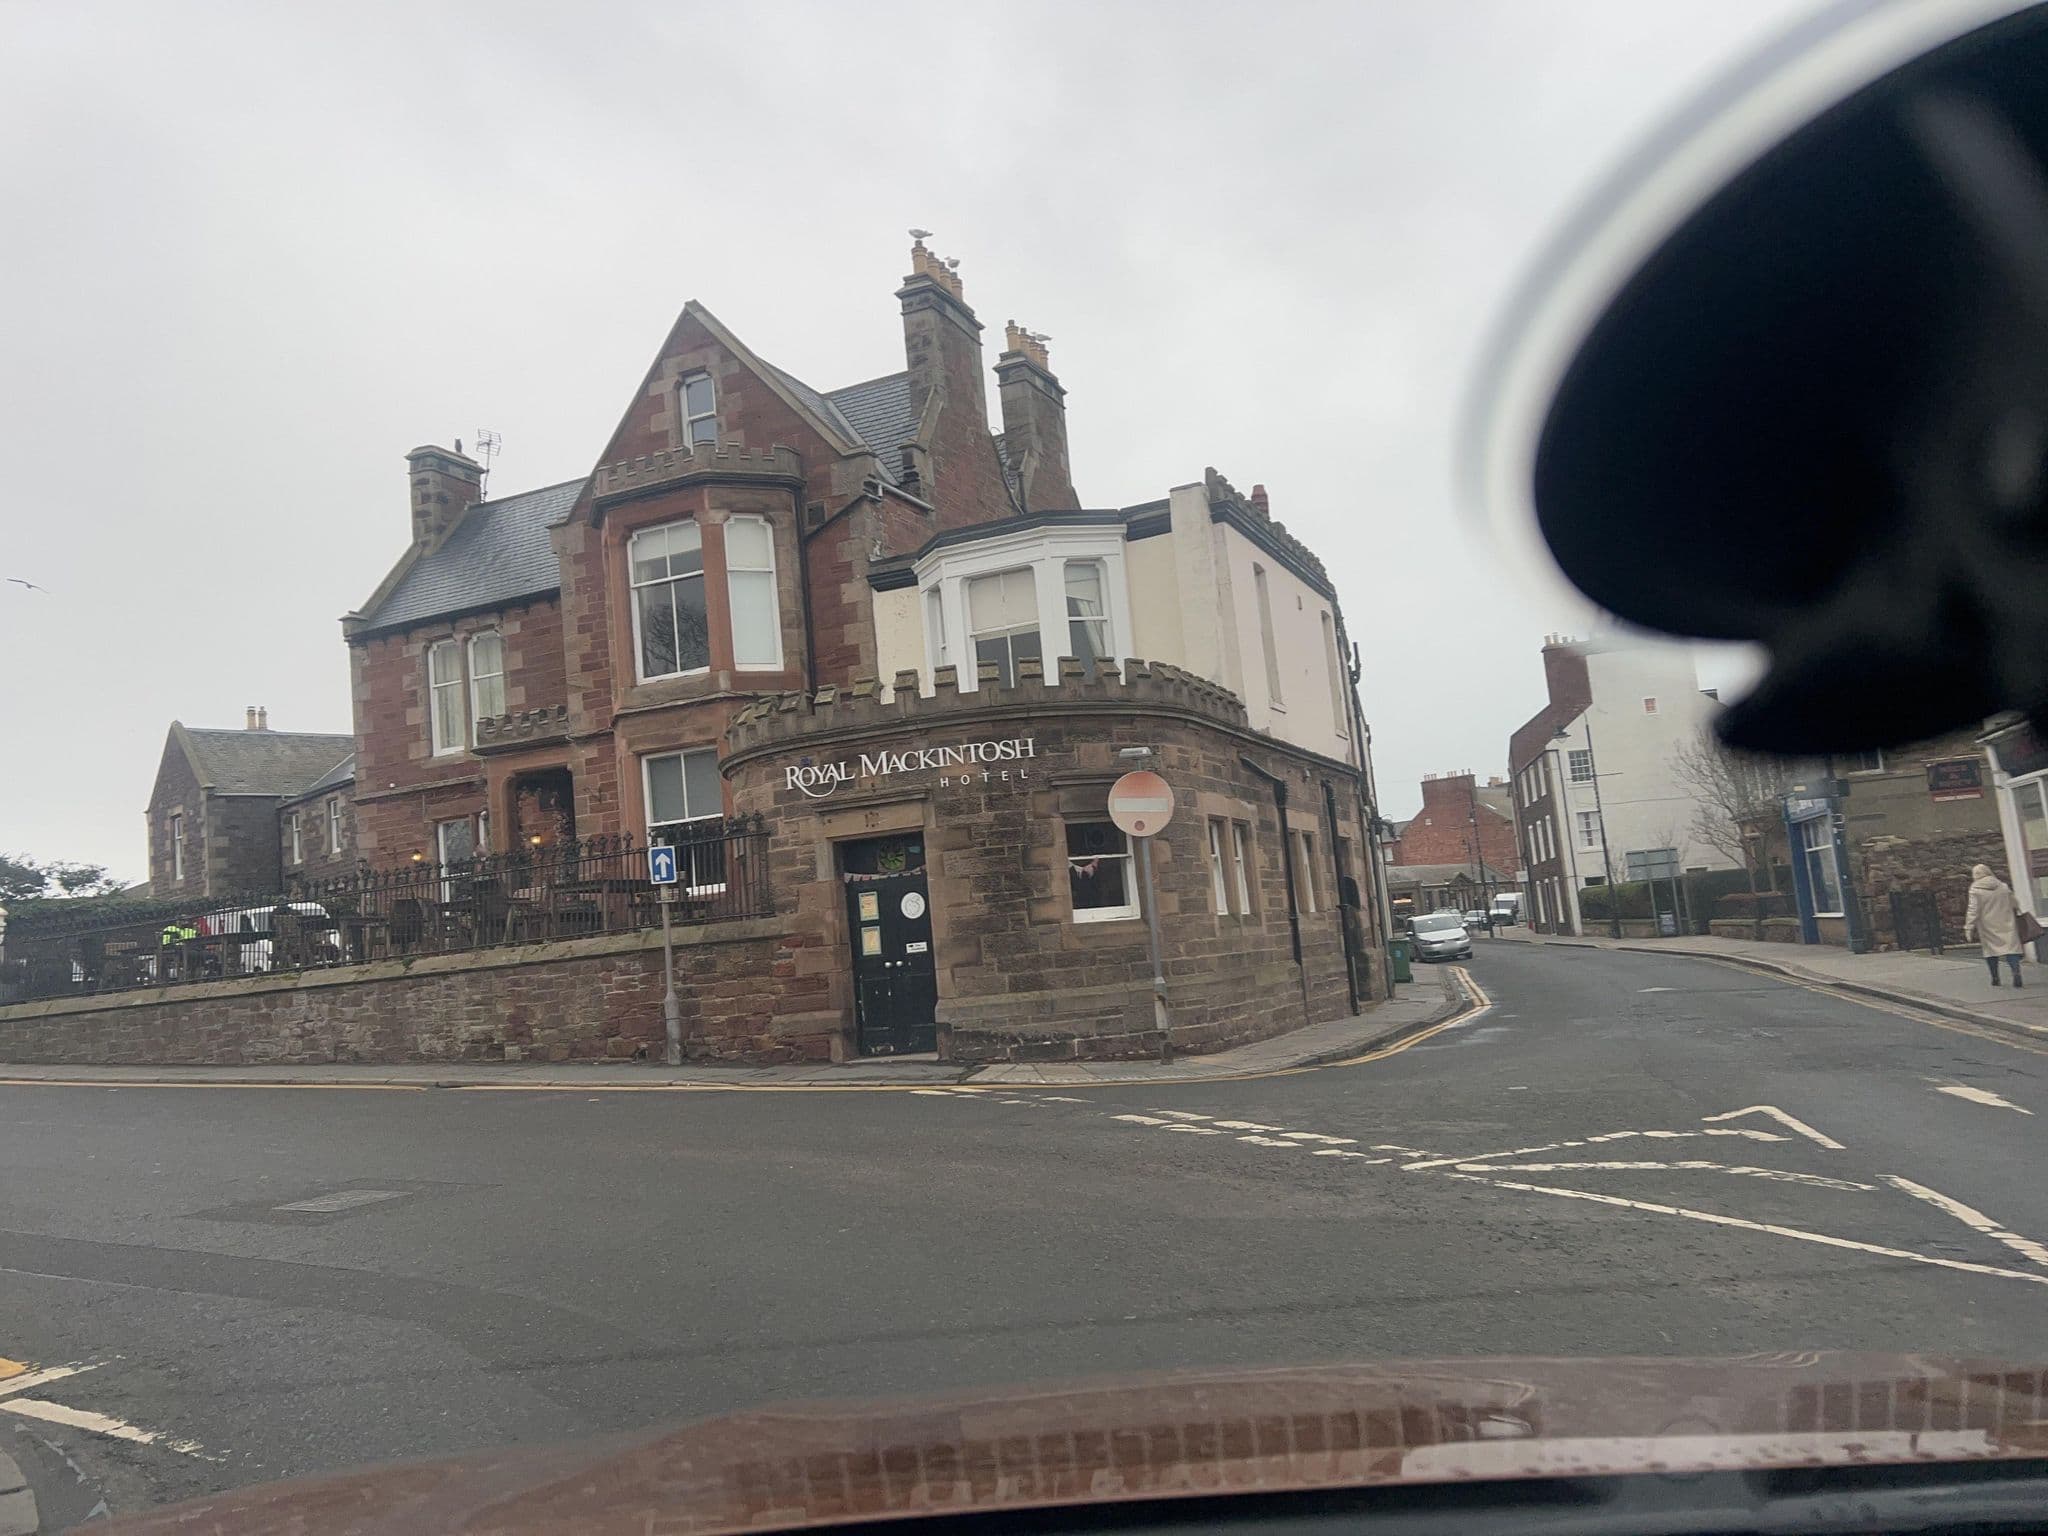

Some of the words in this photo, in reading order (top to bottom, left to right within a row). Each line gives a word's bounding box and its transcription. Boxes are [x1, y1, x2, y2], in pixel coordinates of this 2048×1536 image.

[784, 762, 855, 797] ROYAL
[859, 738, 1036, 778] MACKINTOSH
[940, 769, 1028, 787] HOTEL
